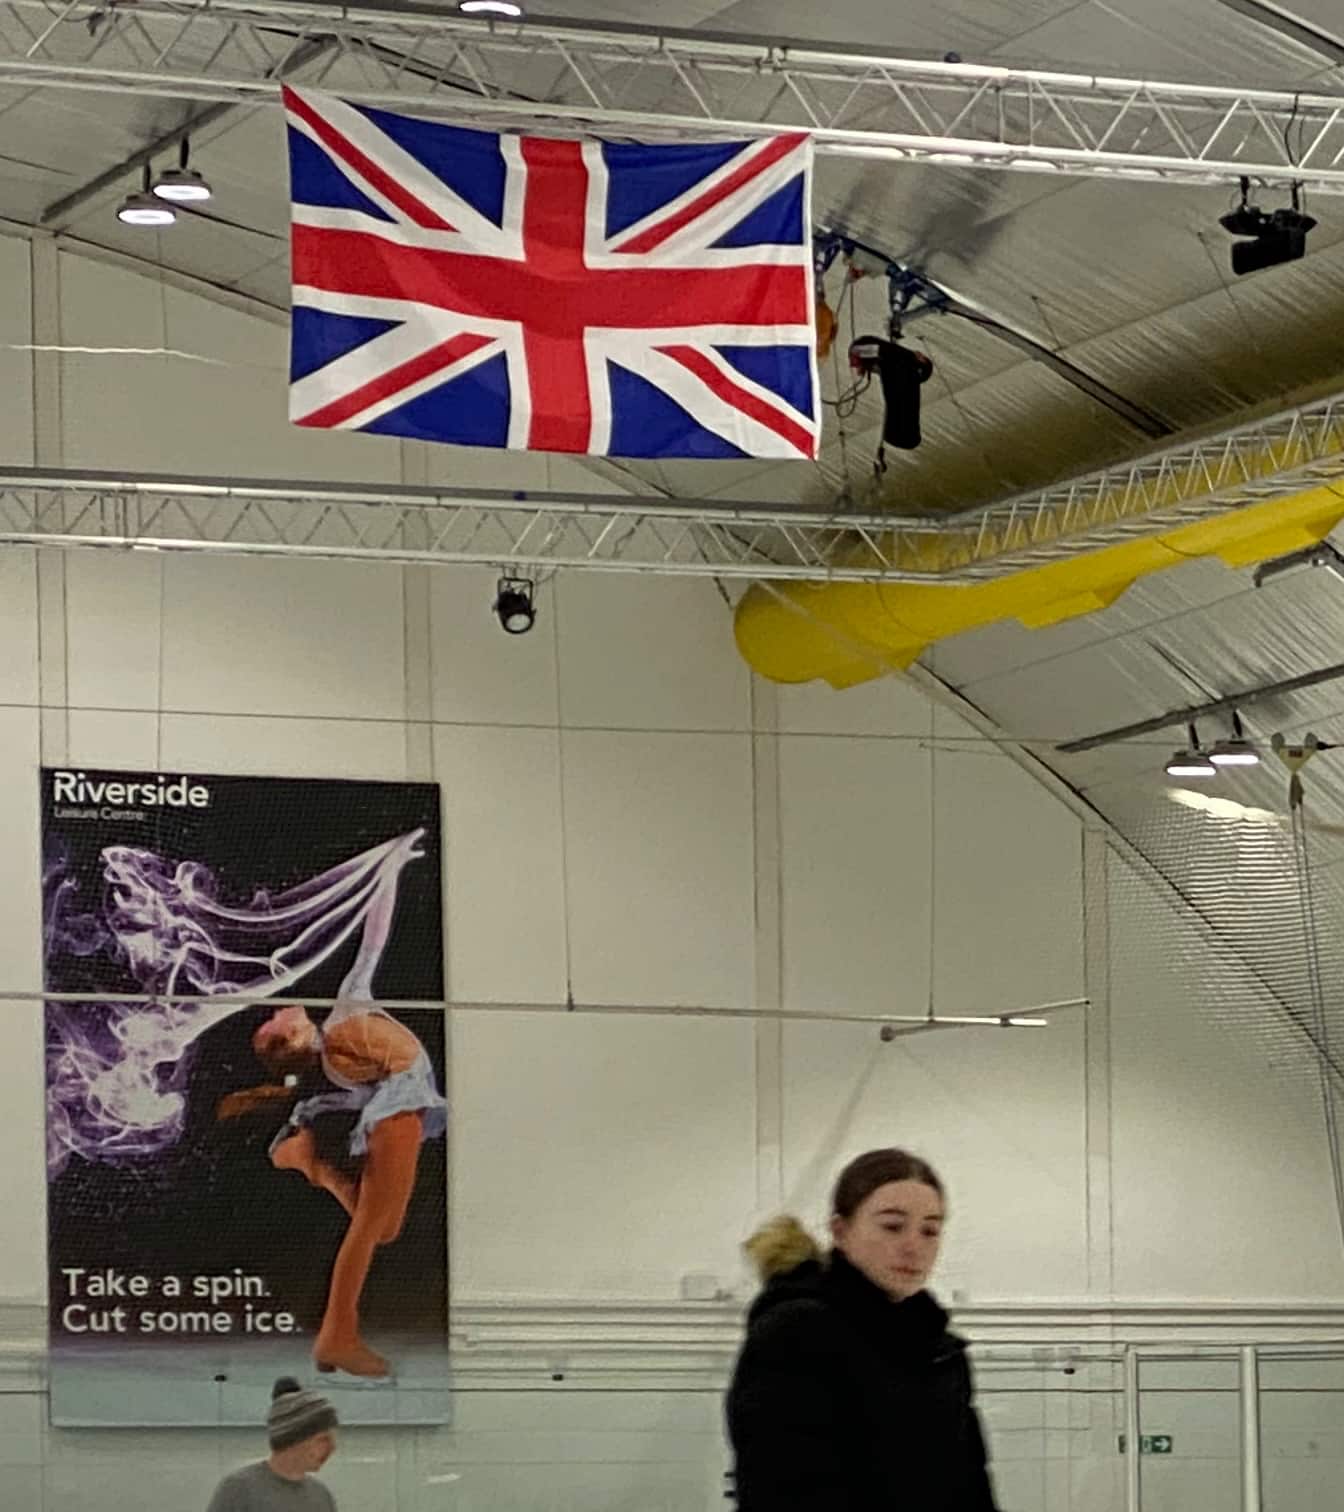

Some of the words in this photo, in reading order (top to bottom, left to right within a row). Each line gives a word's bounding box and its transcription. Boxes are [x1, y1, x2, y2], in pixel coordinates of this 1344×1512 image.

[54, 772, 209, 807] Riverside
[101, 808, 144, 820] Centre
[63, 1268, 149, 1297] Take
[163, 1274, 180, 1297] a
[193, 1269, 271, 1304] spin.
[62, 1304, 126, 1333] Cut
[140, 1309, 232, 1333] some
[245, 1305, 303, 1333] ice.
